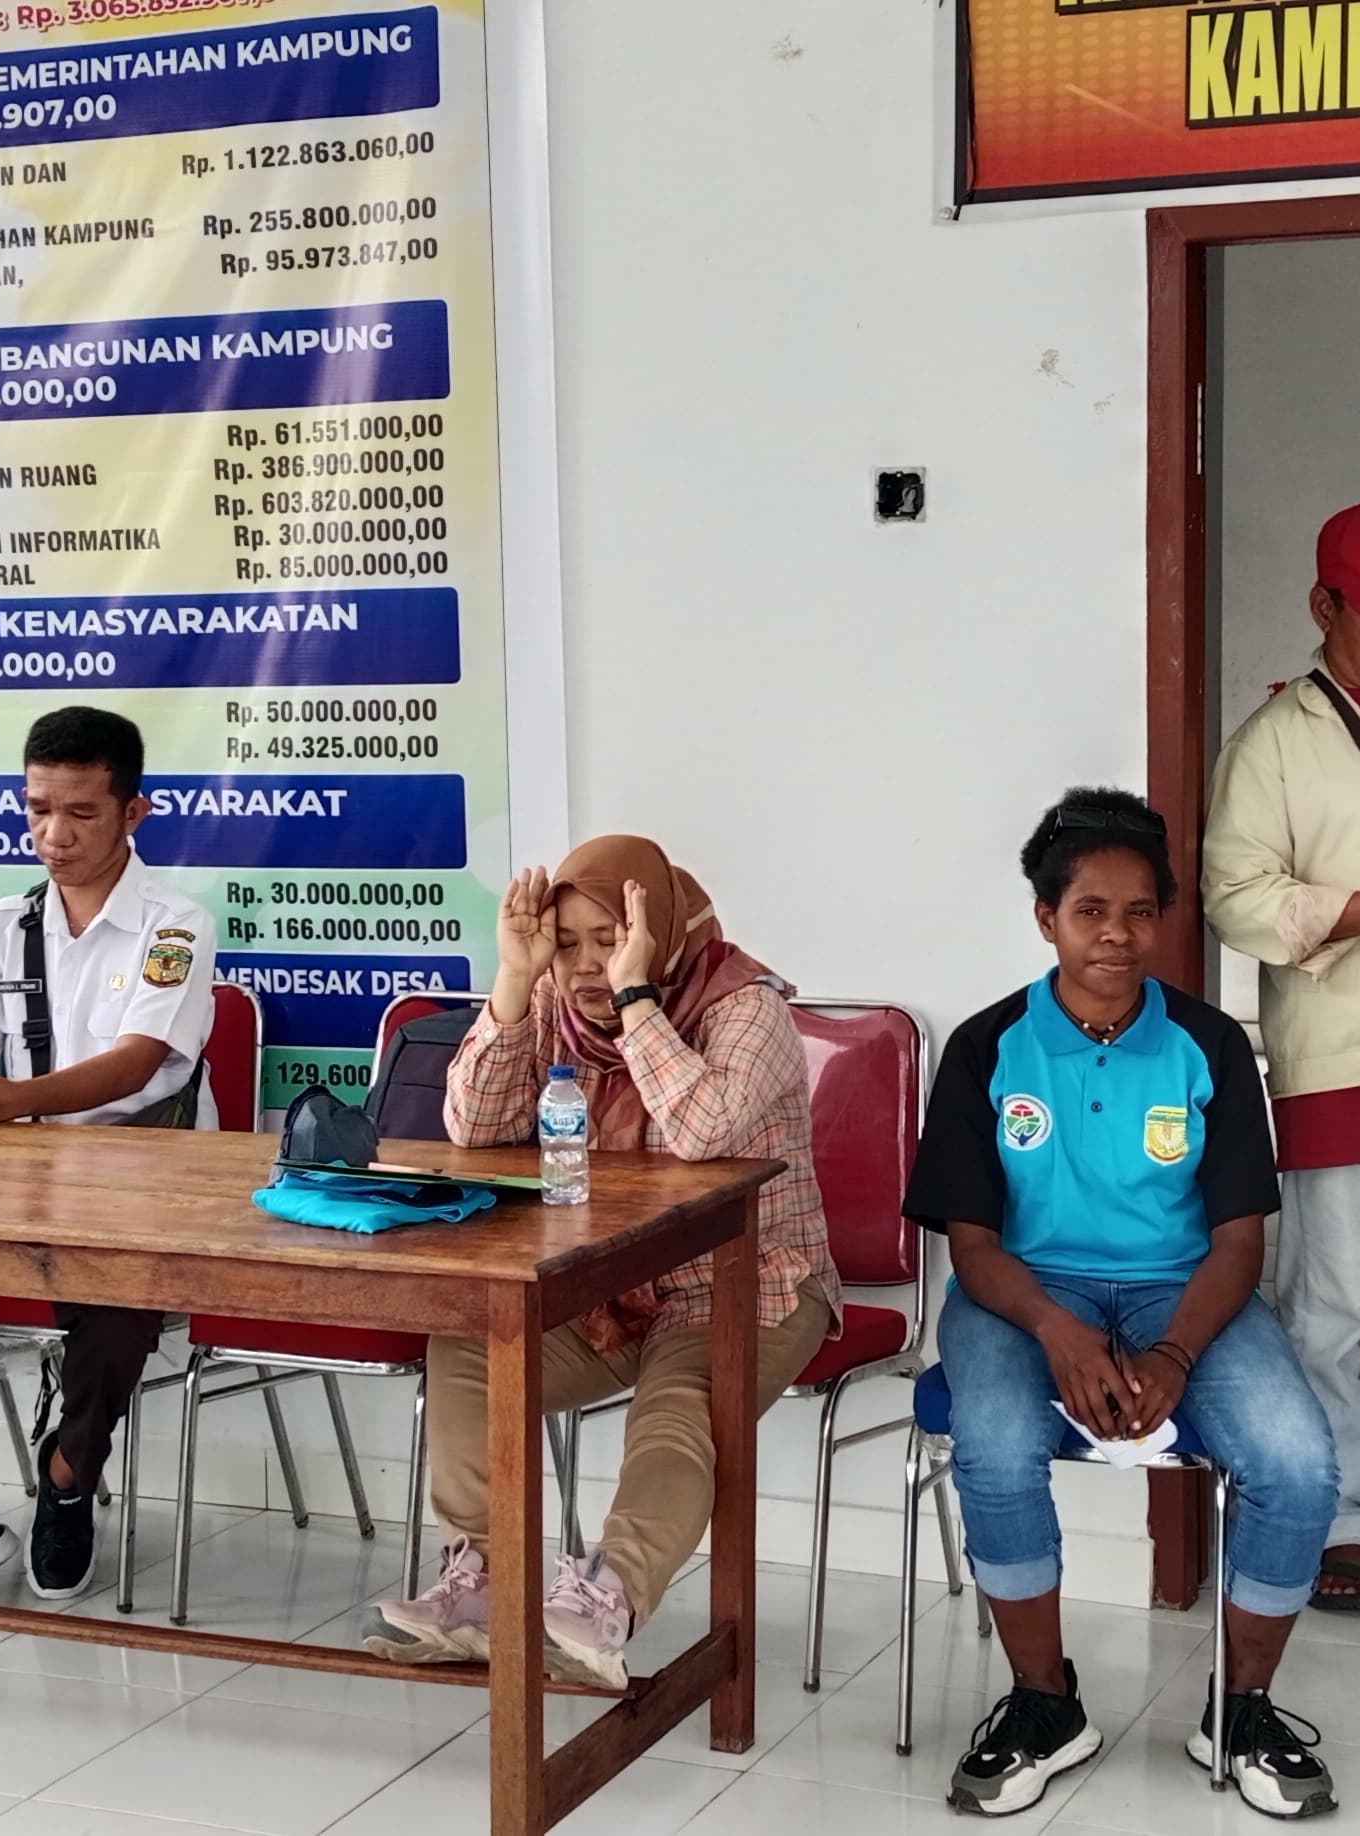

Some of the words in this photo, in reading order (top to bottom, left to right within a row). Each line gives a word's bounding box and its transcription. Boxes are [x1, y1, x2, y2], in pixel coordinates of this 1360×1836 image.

[237, 24, 412, 67] KAMPUNG
[24, 161, 67, 184] DAN
[182, 155, 215, 179] Rp.
[224, 132, 435, 172] 1.122.863.060,00
[45, 218, 155, 247] KAMPUNG
[203, 214, 240, 240] Rp.
[249, 197, 436, 233] 255.800.000,00
[220, 251, 258, 279] Rp.
[266, 237, 438, 273] 95.973.847,00
[212, 322, 395, 360] KAMPUNG
[227, 425, 268, 452] Rp.
[275, 414, 444, 446] 61.551.000,00
[21, 463, 98, 488] RUANG
[214, 459, 255, 486] Rp.
[262, 449, 445, 480] 386.900.000,00
[215, 494, 254, 521] Rp.
[262, 485, 444, 515] 603.820.000,00
[11, 528, 161, 554] INFORMATIKA
[234, 524, 271, 552] Rp.
[279, 517, 447, 547] 30.000.000,00
[236, 557, 272, 585] Rp.
[279, 550, 448, 580] 85.000.000,00
[0, 603, 359, 638] KEMASYARAKATAN
[226, 702, 260, 725] Rp.
[267, 699, 438, 727] 50.000.000,00
[227, 738, 260, 762] Rp.
[267, 735, 439, 762] 49.325.000,00
[139, 789, 348, 817] SYARAKAT
[227, 882, 263, 908] Rp.
[271, 881, 444, 909] 30.000.000,00
[228, 917, 265, 944] Rp.
[273, 918, 462, 948] 166.000.000,00
[215, 967, 364, 996] MENDESAK
[371, 970, 447, 996] DESA
